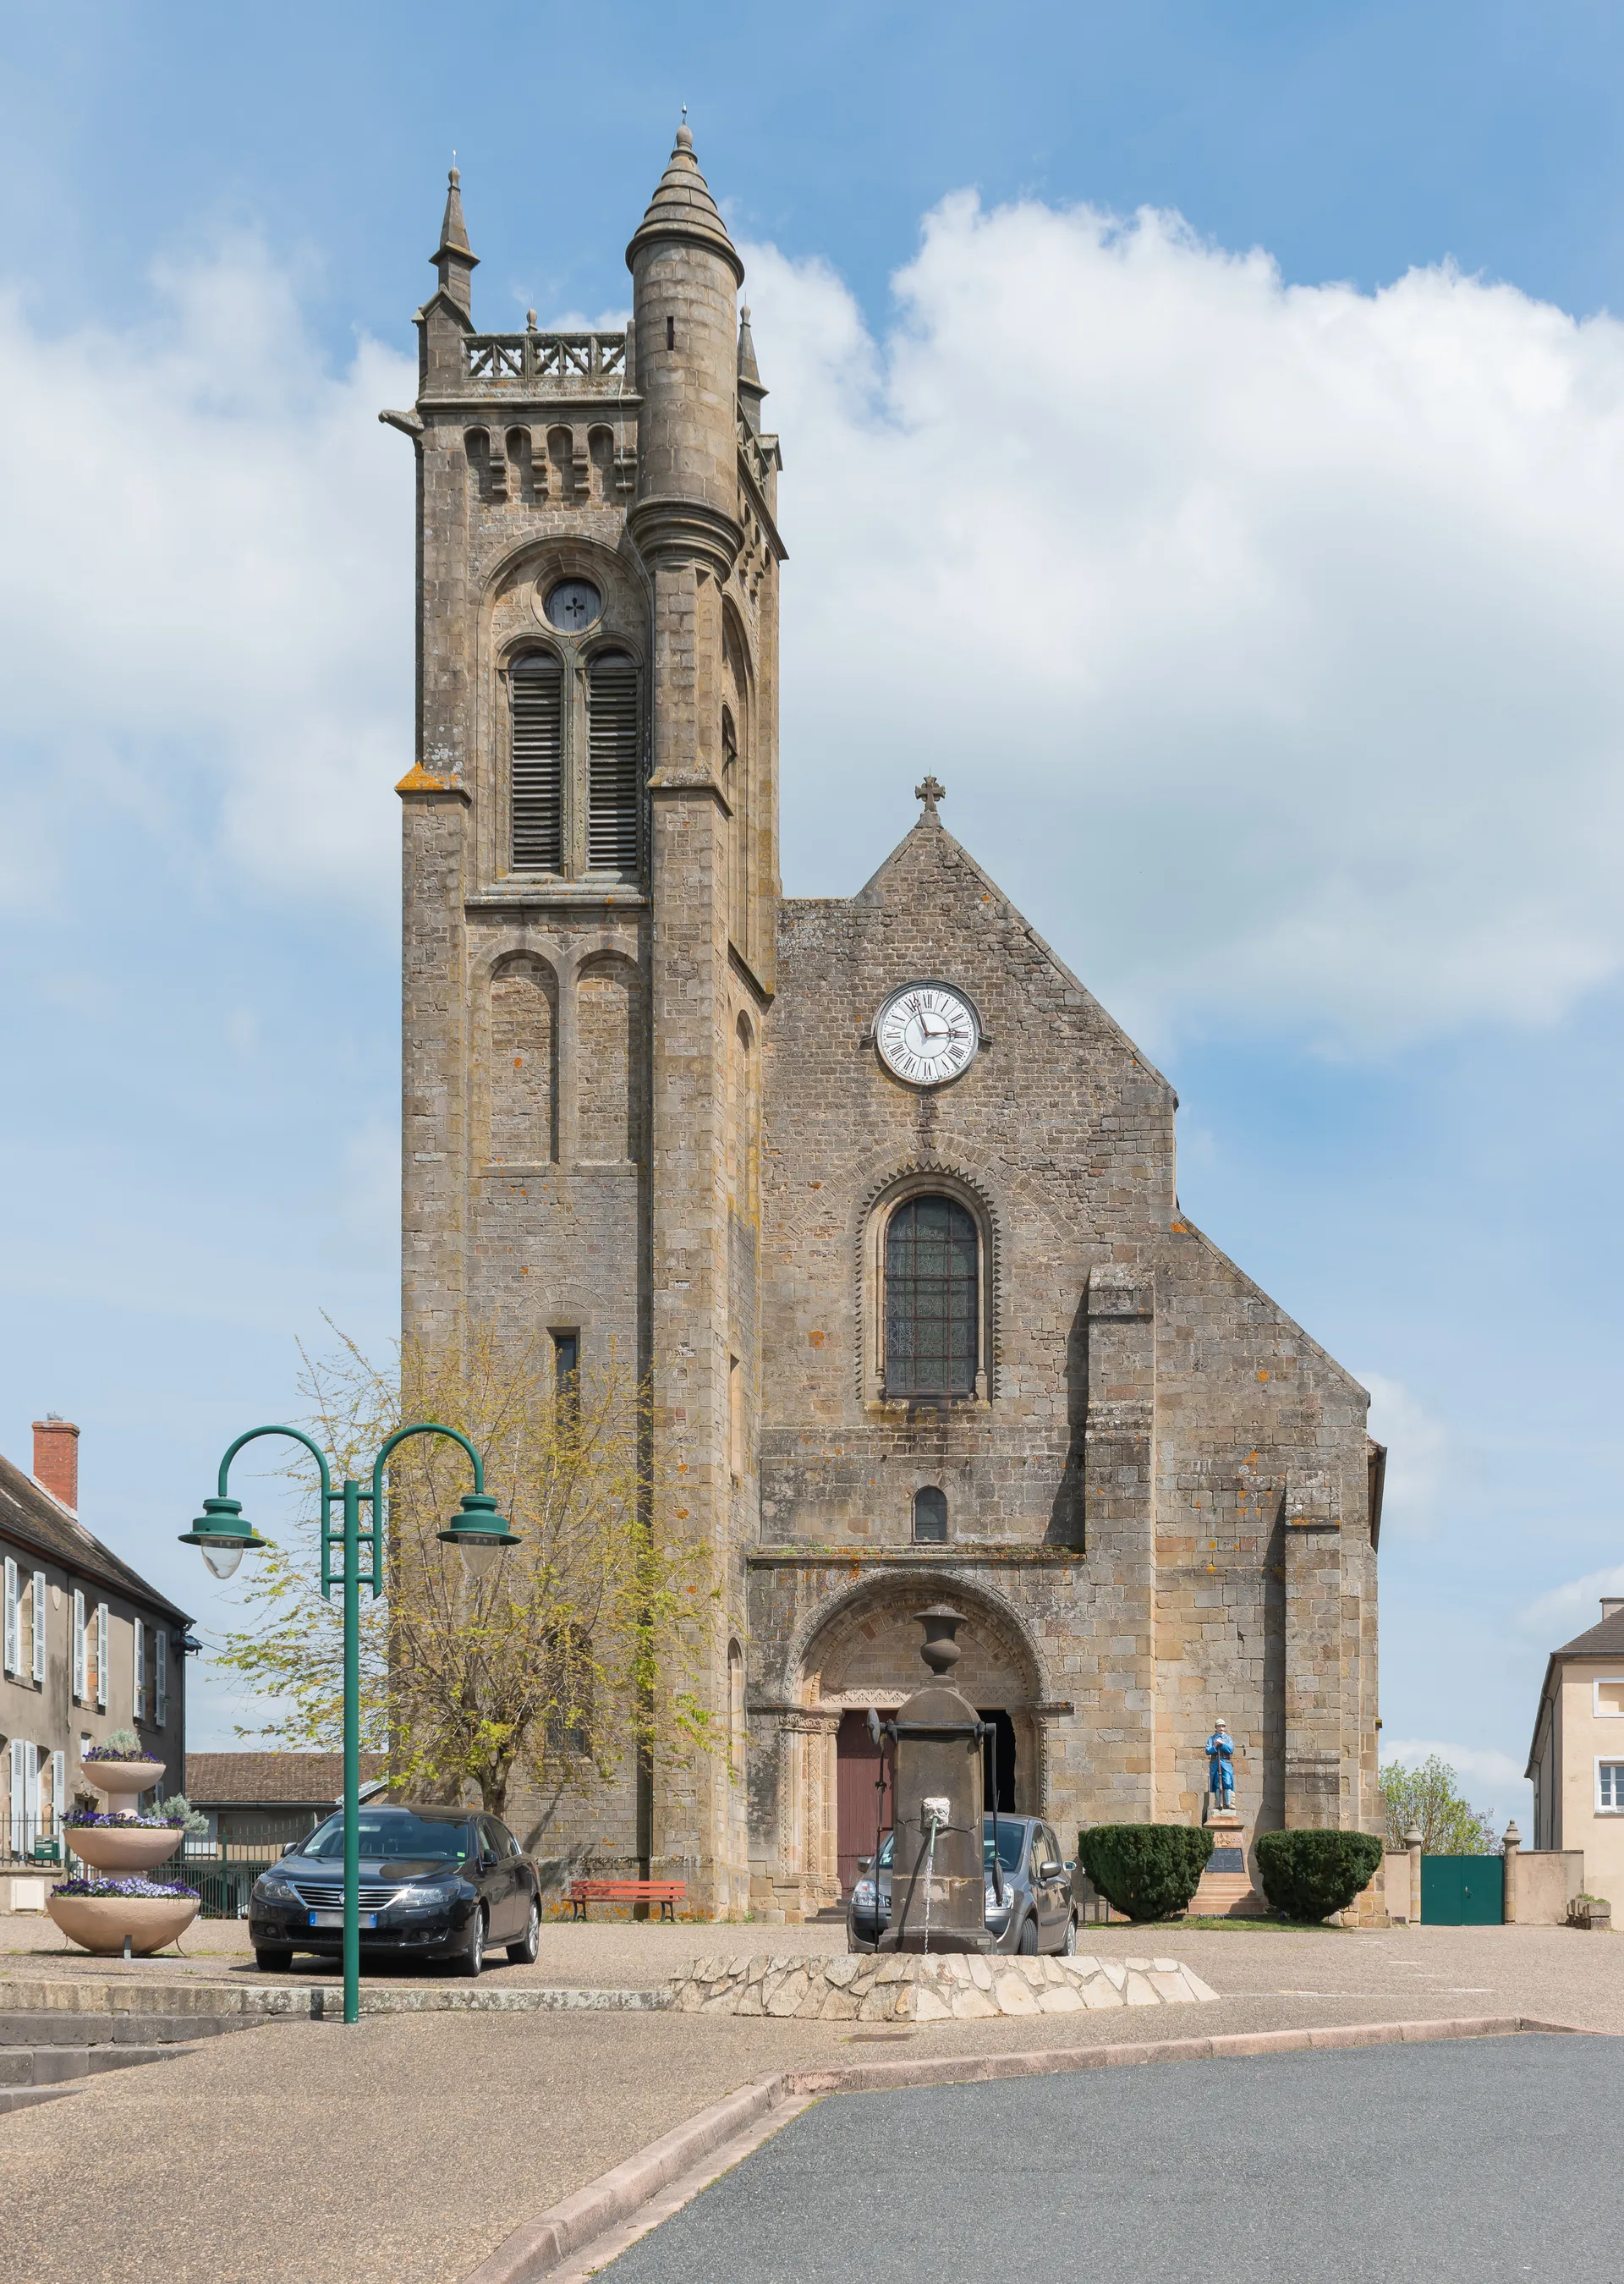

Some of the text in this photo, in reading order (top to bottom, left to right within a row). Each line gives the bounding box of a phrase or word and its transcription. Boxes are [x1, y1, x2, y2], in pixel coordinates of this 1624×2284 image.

[923, 994, 932, 1008] XII
[941, 999, 949, 1012] I
[950, 1013, 964, 1024] II
[903, 1056, 917, 1073] VII
